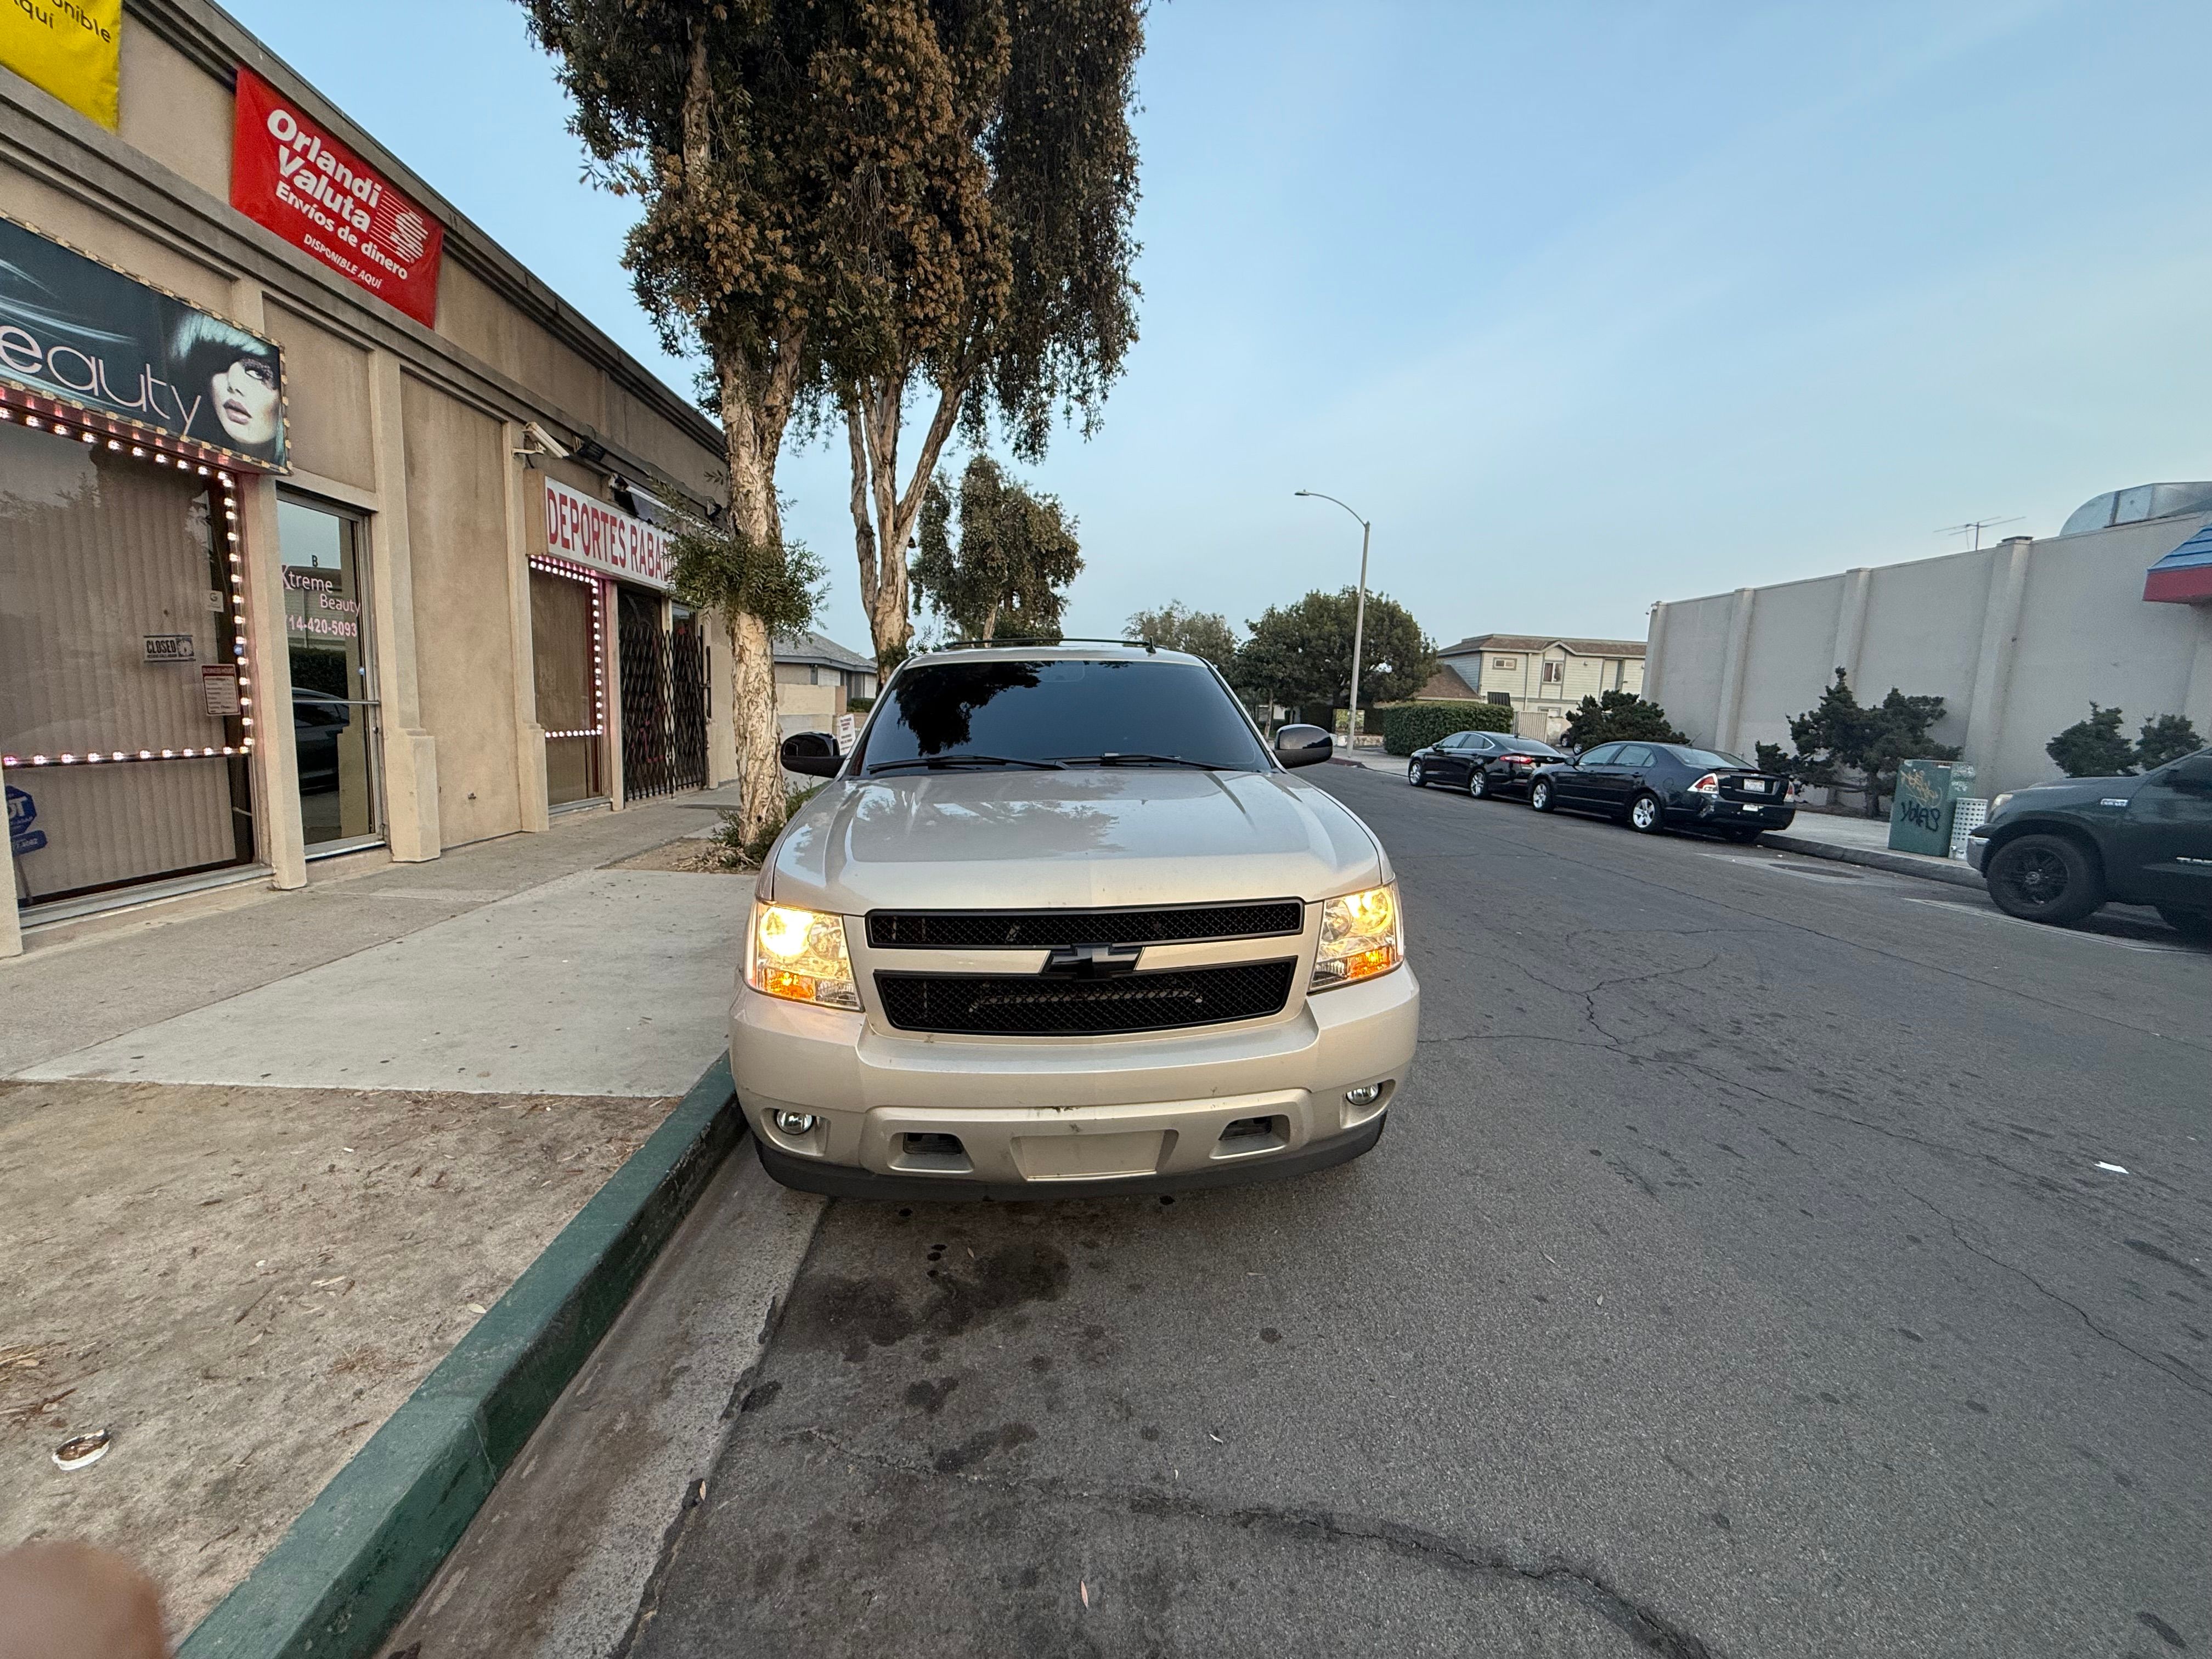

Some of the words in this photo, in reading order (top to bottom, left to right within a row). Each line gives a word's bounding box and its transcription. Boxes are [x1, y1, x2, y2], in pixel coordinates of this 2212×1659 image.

[14, 0, 53, 29] qui
[267, 109, 382, 208] Orlandi
[279, 145, 371, 233] Valuta
[276, 180, 335, 232] Envíos
[337, 225, 358, 247] de
[361, 241, 408, 280] dinero
[303, 234, 358, 275] DISPONIBLE
[547, 487, 627, 568] DEPORTES
[311, 554, 319, 567] B
[320, 593, 360, 617] Beauty
[285, 614, 357, 637] 14-420-5093
[146, 640, 176, 653] CLOSED
